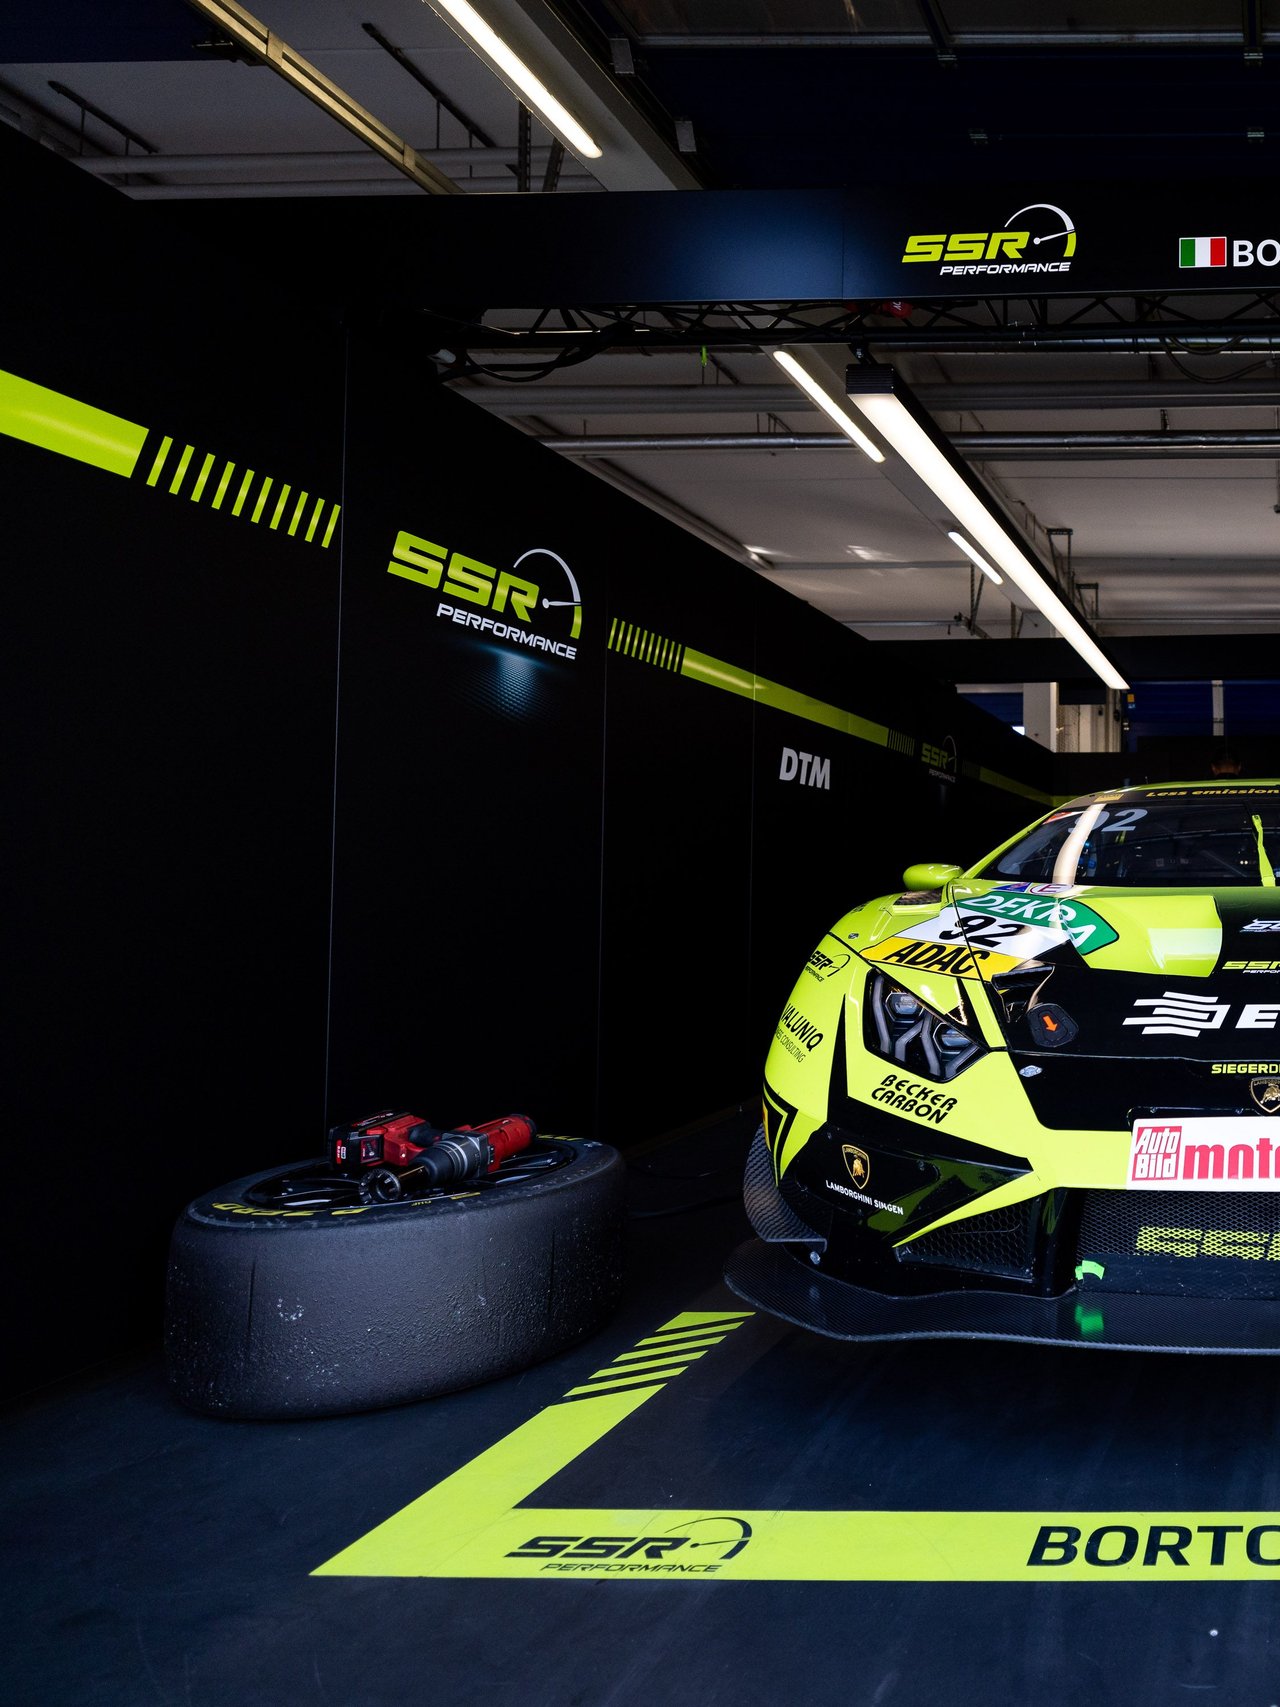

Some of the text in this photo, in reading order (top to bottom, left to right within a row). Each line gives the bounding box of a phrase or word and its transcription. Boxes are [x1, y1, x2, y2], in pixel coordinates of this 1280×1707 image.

[902, 231, 1030, 263] SSR
[940, 262, 1071, 275] PERFORMANCE
[387, 530, 540, 623] SSR
[436, 603, 577, 660] PERFORMANCE
[779, 746, 831, 791] DTM
[920, 741, 948, 770] SSR
[939, 915, 1032, 948] 92
[961, 895, 1096, 949] DEKRA
[882, 941, 990, 974] ADAC
[871, 1087, 949, 1124] CARBON
[881, 1074, 958, 1112] BECKER
[1135, 1128, 1180, 1154] Auto
[1134, 1153, 1178, 1178] Bild
[825, 1179, 873, 1206] LAMBORGHINI
[503, 1536, 692, 1559] SSR
[540, 1563, 722, 1573] PERFORMANCE
